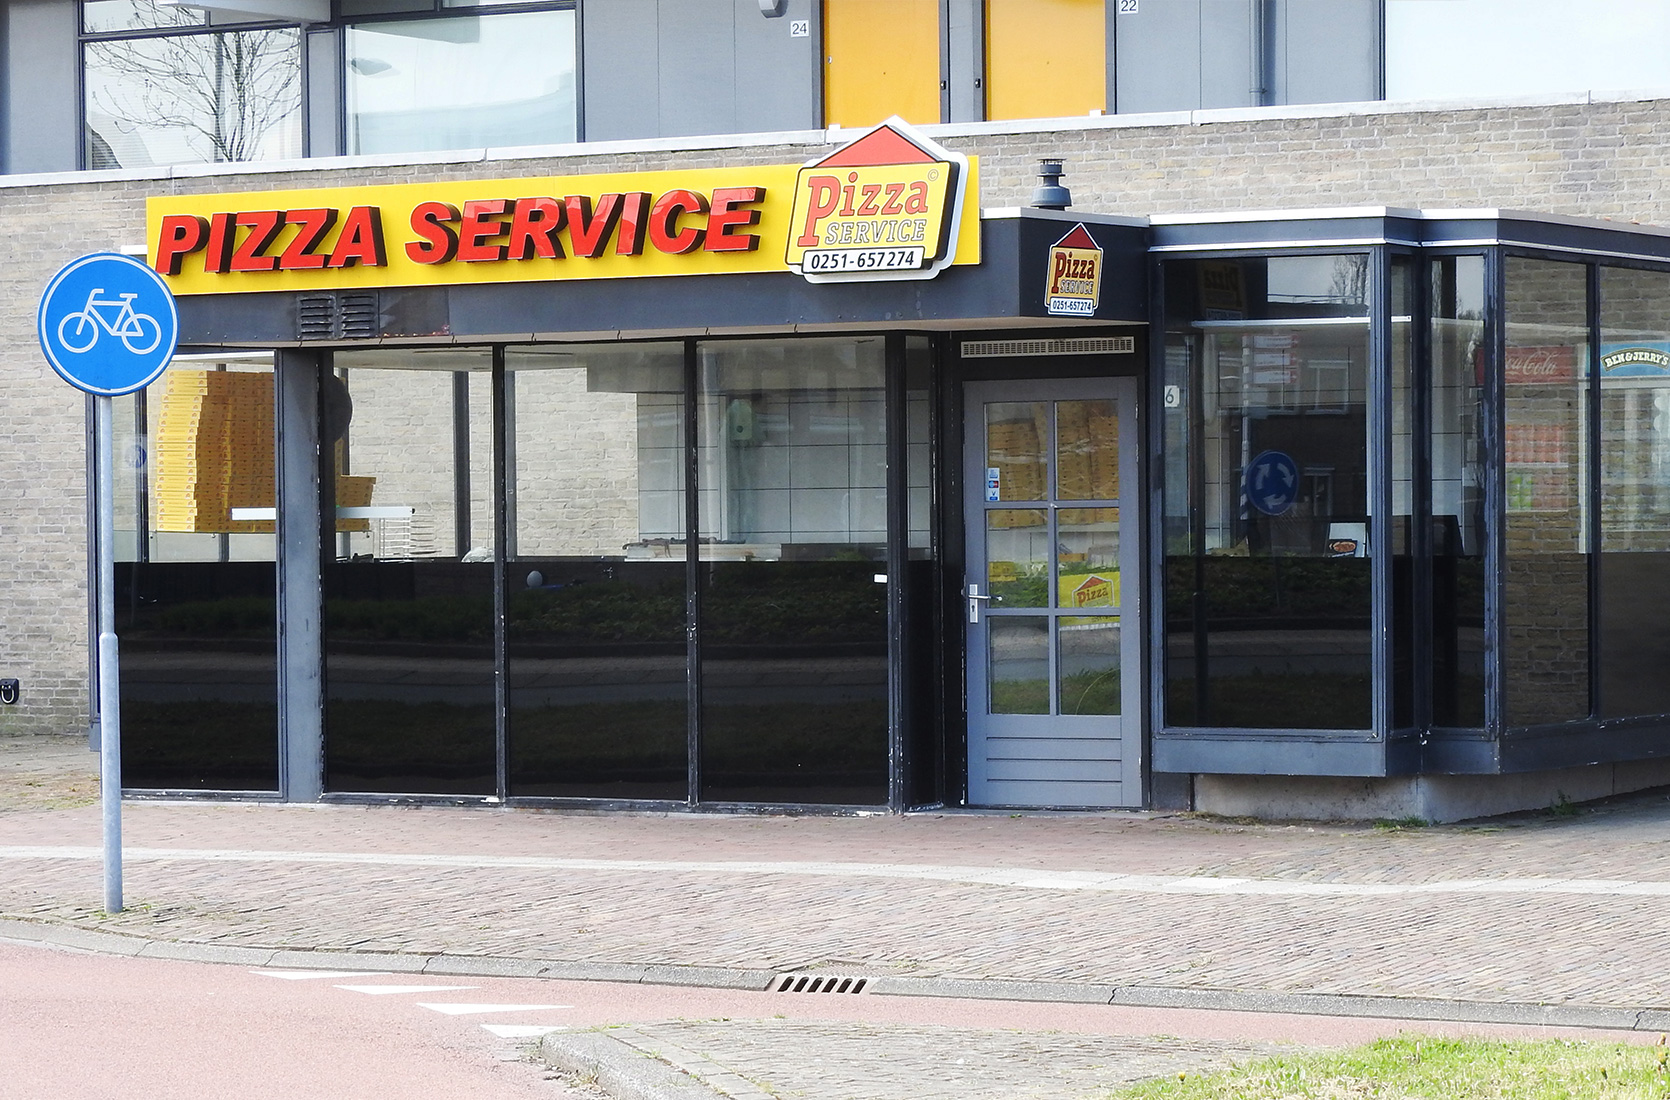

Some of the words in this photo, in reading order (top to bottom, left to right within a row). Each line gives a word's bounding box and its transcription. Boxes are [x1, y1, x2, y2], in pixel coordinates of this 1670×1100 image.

[1121, 0, 1137, 11] 22
[792, 22, 807, 34] 24
[797, 171, 929, 247] Pizza
[155, 206, 387, 276] PIZZA
[405, 187, 766, 265] SERVICE
[825, 219, 927, 245] SERVICE
[811, 250, 915, 269] 0251-657274
[1051, 251, 1095, 294] Pizza
[1060, 279, 1094, 295] SERVICE
[1052, 300, 1092, 311] 0251-657274
[1165, 387, 1174, 404] 6
[1077, 587, 1109, 608] Pizza
